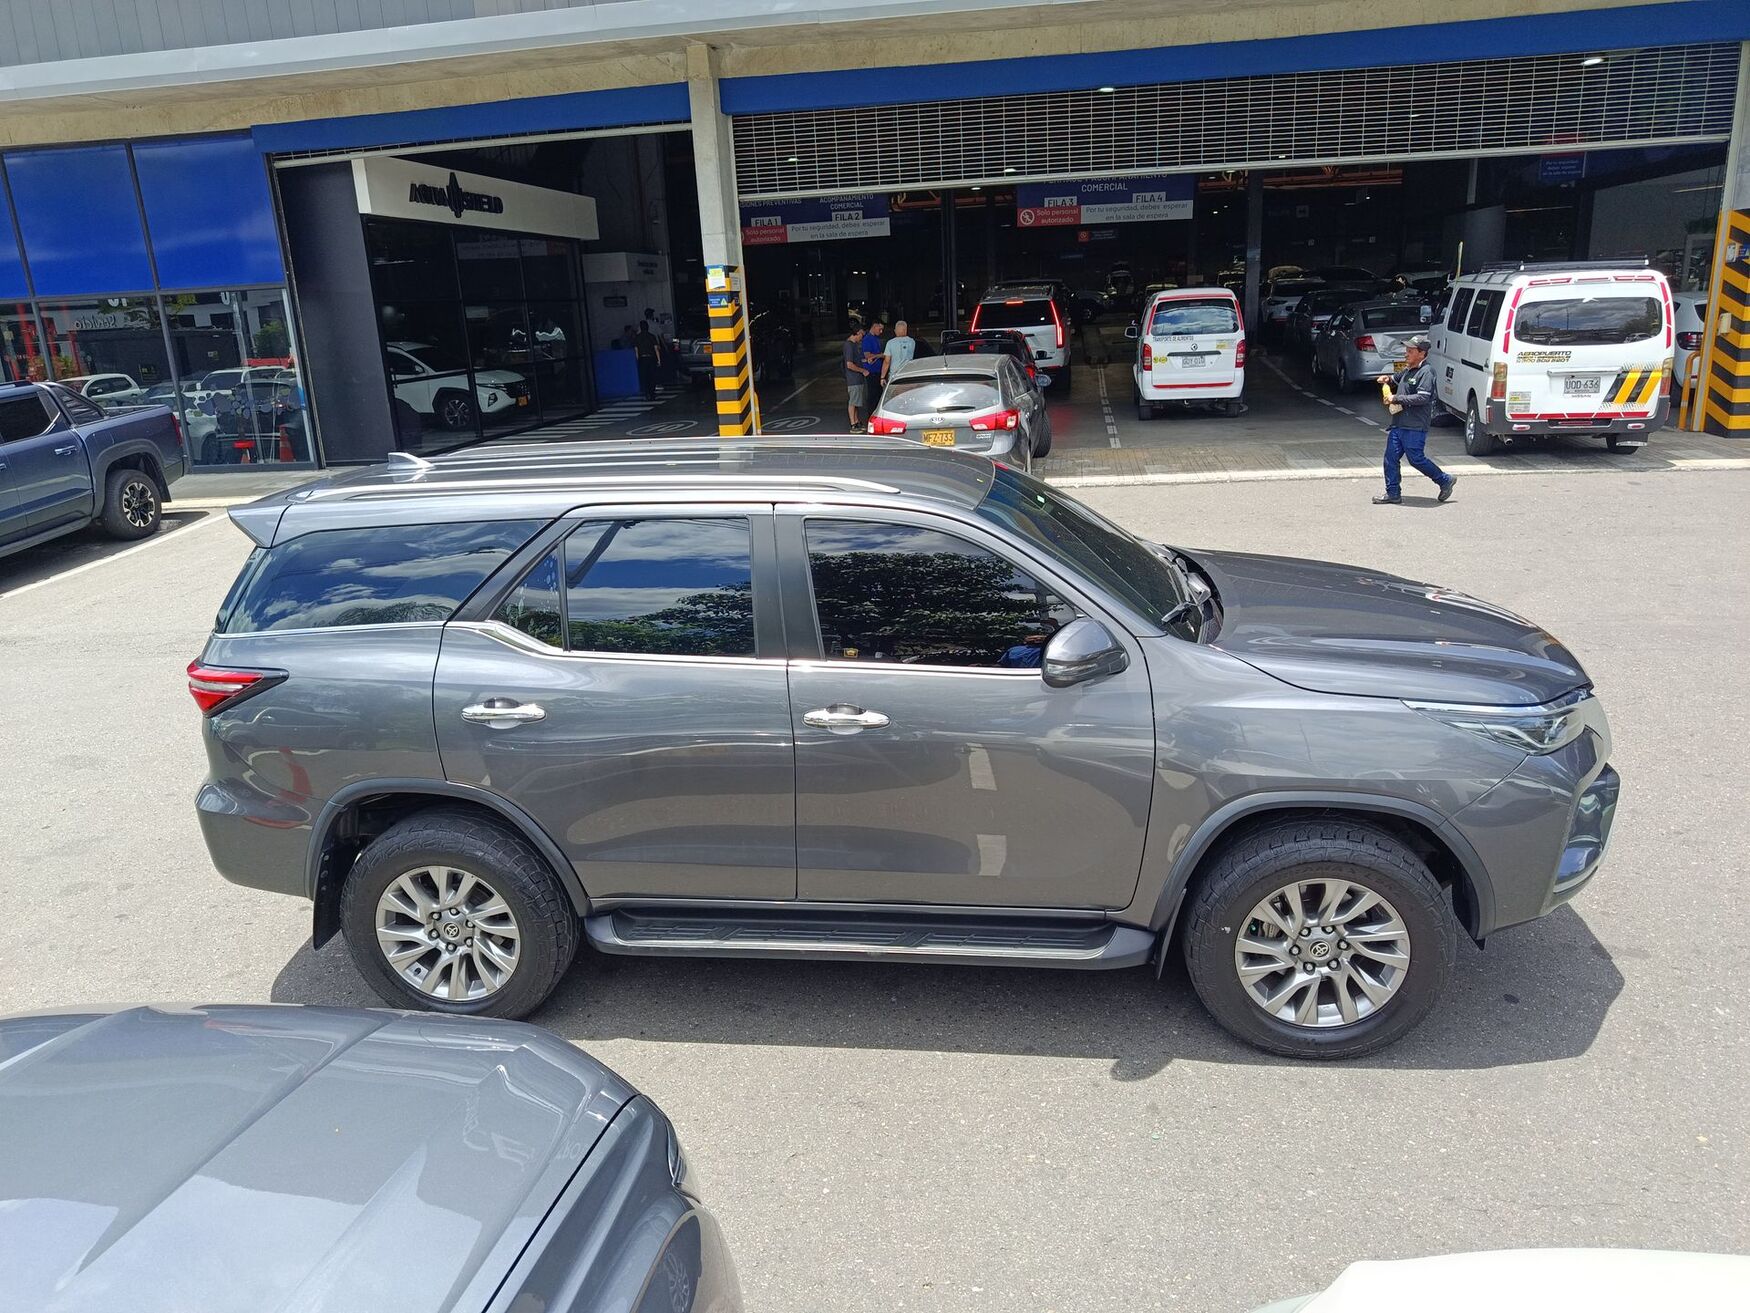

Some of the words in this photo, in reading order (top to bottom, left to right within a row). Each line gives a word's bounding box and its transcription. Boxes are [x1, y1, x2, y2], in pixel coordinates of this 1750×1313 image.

[1081, 184, 1128, 192] COMERCIAL
[1135, 194, 1155, 203] FILA
[830, 202, 864, 210] COMERCIAL
[1048, 199, 1067, 207] FILA
[834, 213, 853, 221] FILA
[755, 218, 773, 226] FILA
